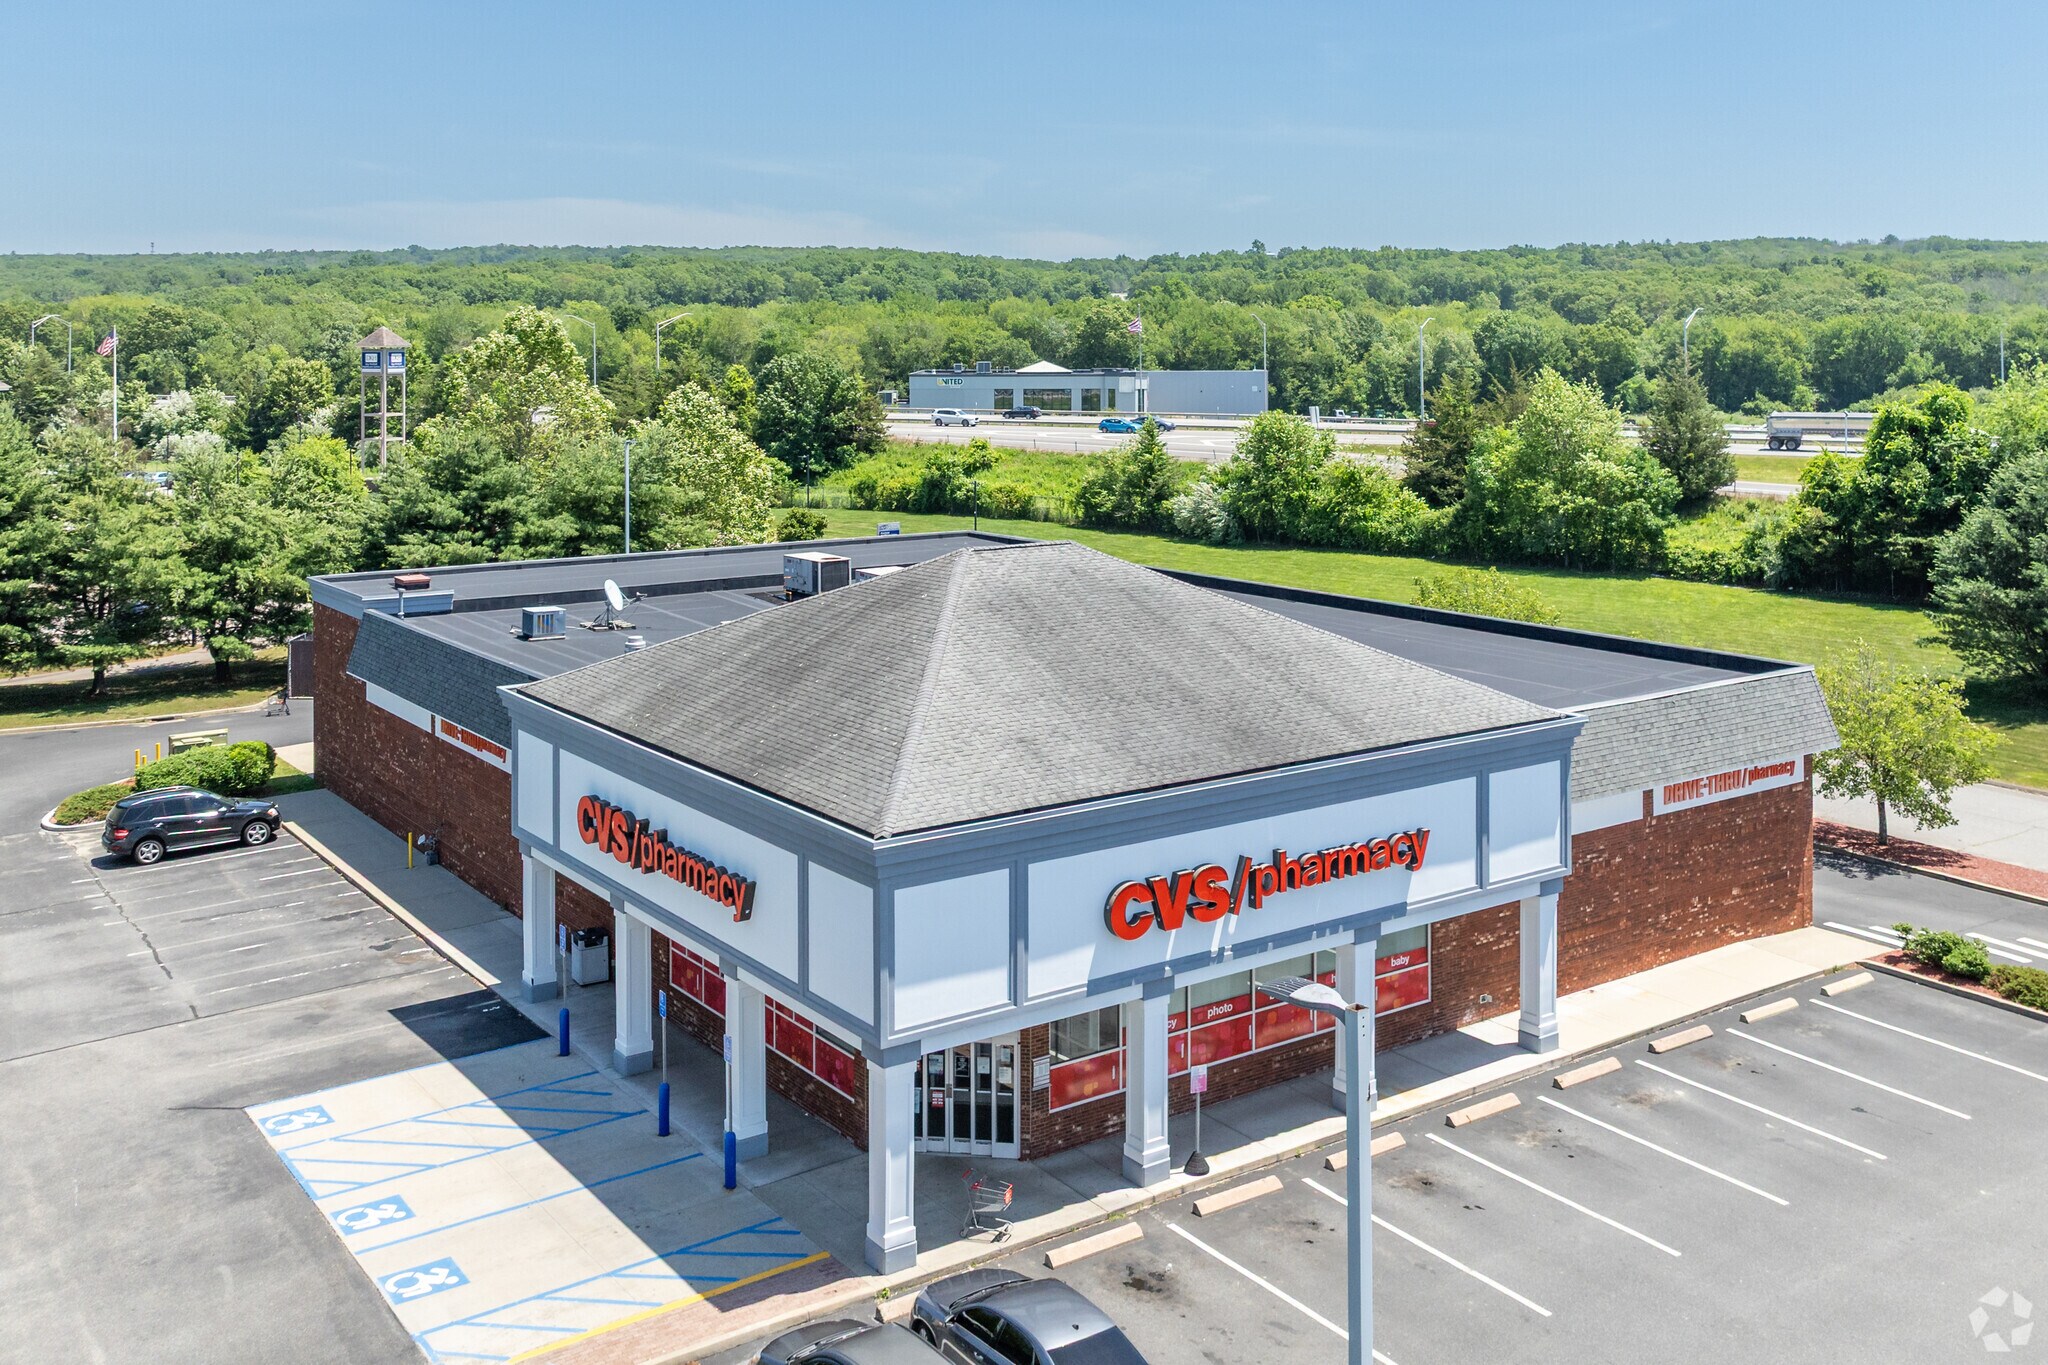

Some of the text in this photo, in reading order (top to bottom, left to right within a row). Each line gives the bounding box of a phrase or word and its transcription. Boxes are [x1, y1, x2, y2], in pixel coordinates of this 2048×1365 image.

[577, 795, 756, 922] CVS/pharmacy
[1104, 828, 1431, 941] CVS/pharmacy
[1391, 955, 1410, 967] baby
[1207, 1003, 1233, 1019] photo
